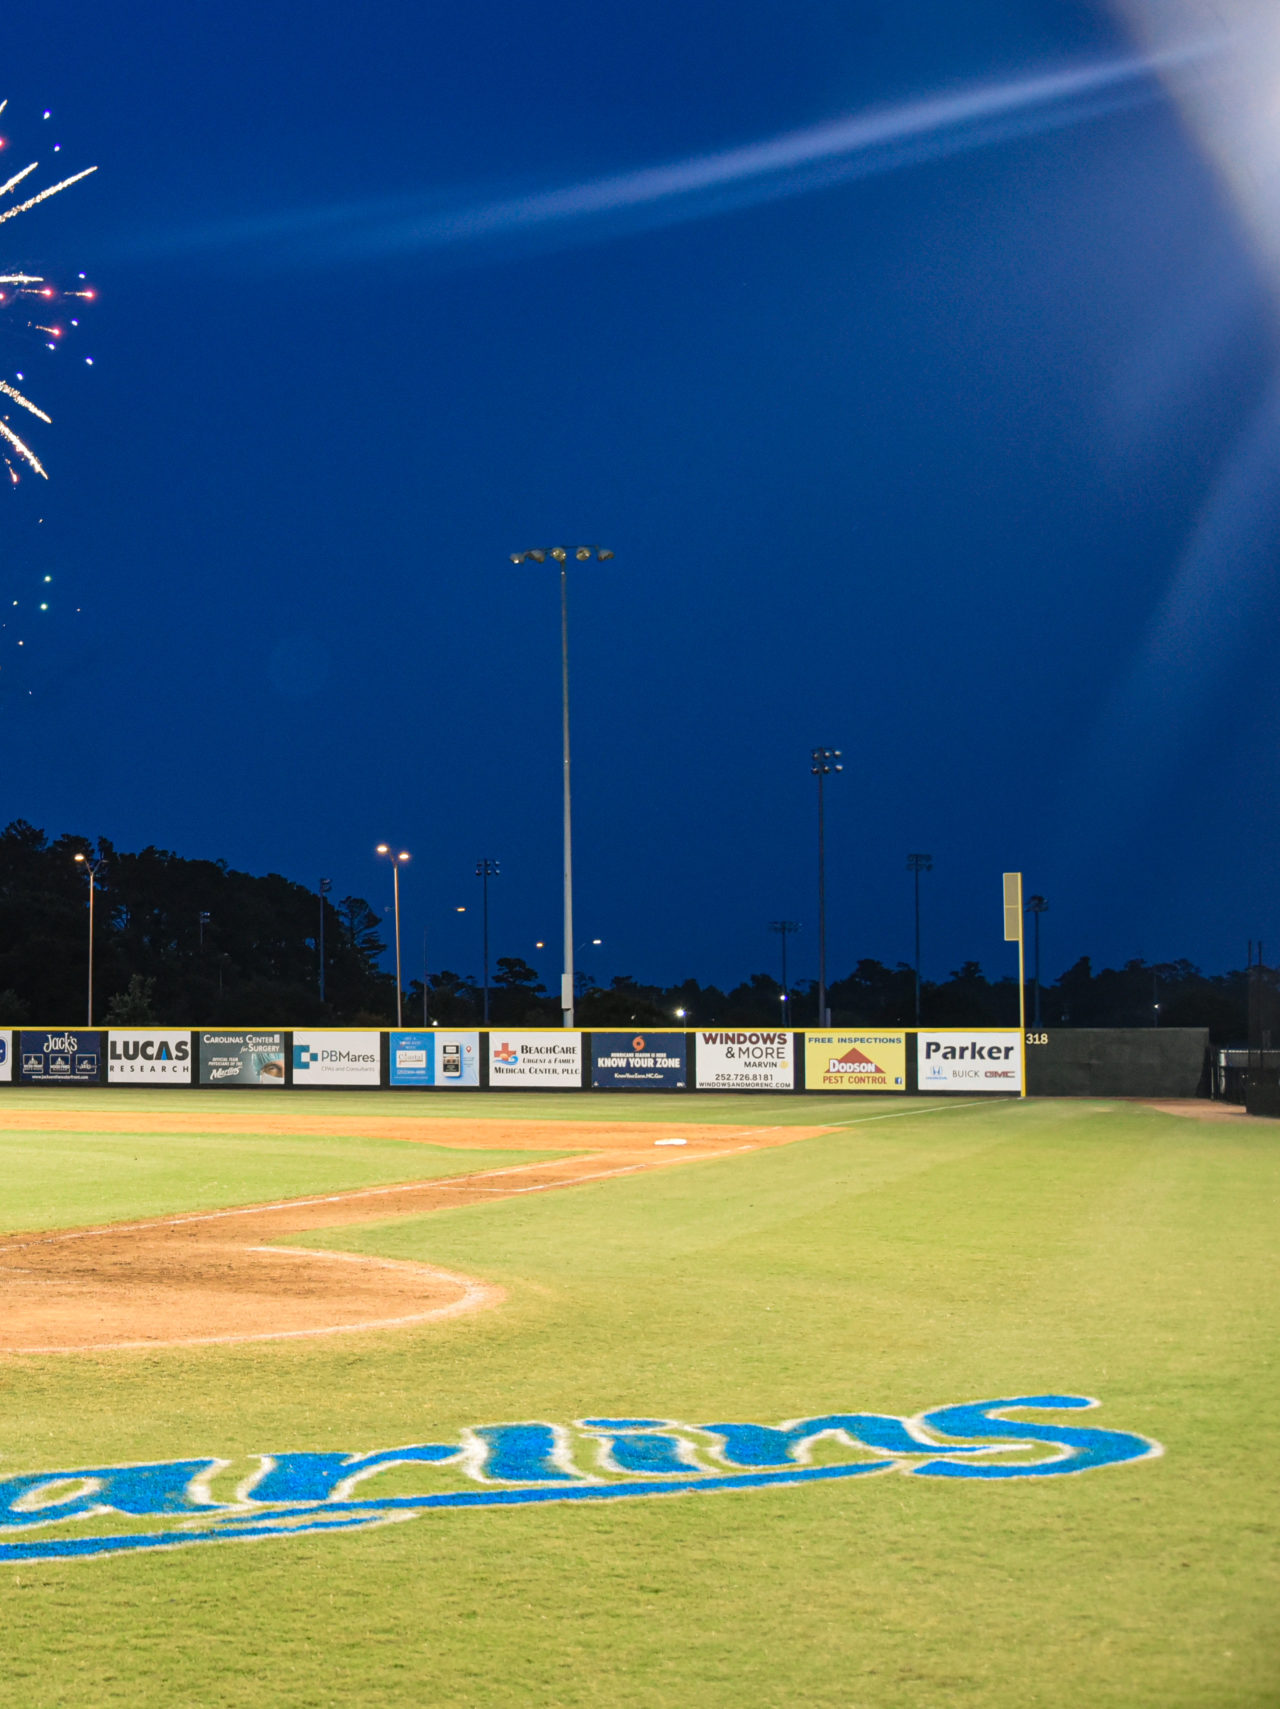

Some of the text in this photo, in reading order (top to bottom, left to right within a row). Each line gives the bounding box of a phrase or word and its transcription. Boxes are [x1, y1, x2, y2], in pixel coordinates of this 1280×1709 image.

[203, 1035, 273, 1043] CAROLINAS CENTER
[702, 1032, 787, 1045] WINDOWS
[1026, 1033, 1049, 1044] 318
[110, 1041, 189, 1061] LUCAS
[249, 1044, 280, 1052] SURGERY
[725, 1046, 785, 1059] & MORE
[925, 1041, 1014, 1060] Parker
[321, 1050, 376, 1063] PBMares
[598, 1058, 680, 1068] KNOW YOUR ZONE
[829, 1059, 876, 1073] DODSON
[210, 1066, 242, 1080] Marlins
[952, 1070, 980, 1078] BUICK
[984, 1070, 1016, 1079] GMC
[823, 1075, 887, 1085] PEST CONTROL
